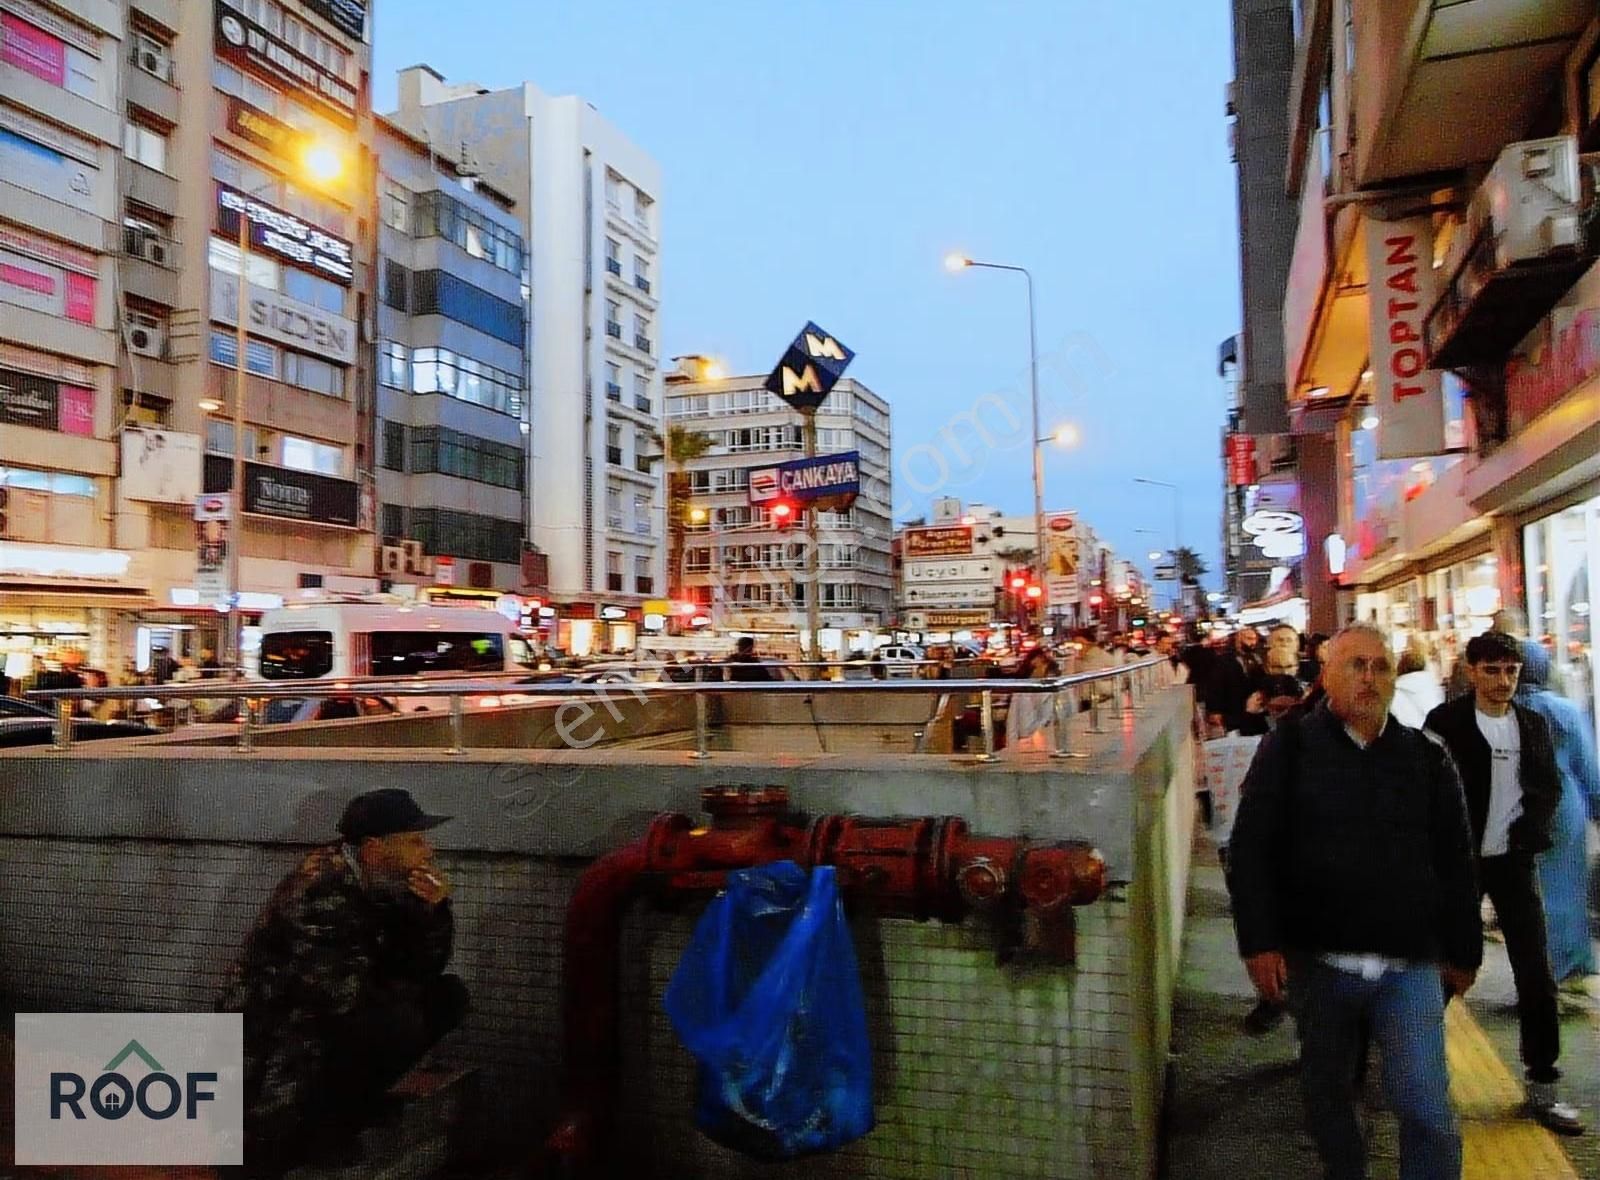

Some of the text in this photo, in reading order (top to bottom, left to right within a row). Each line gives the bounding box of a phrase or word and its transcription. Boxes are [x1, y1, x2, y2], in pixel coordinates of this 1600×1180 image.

[1385, 236, 1426, 402] TOPTAN
[806, 333, 847, 360] M
[783, 363, 823, 396] M
[781, 461, 858, 497] ÇANKAYA
